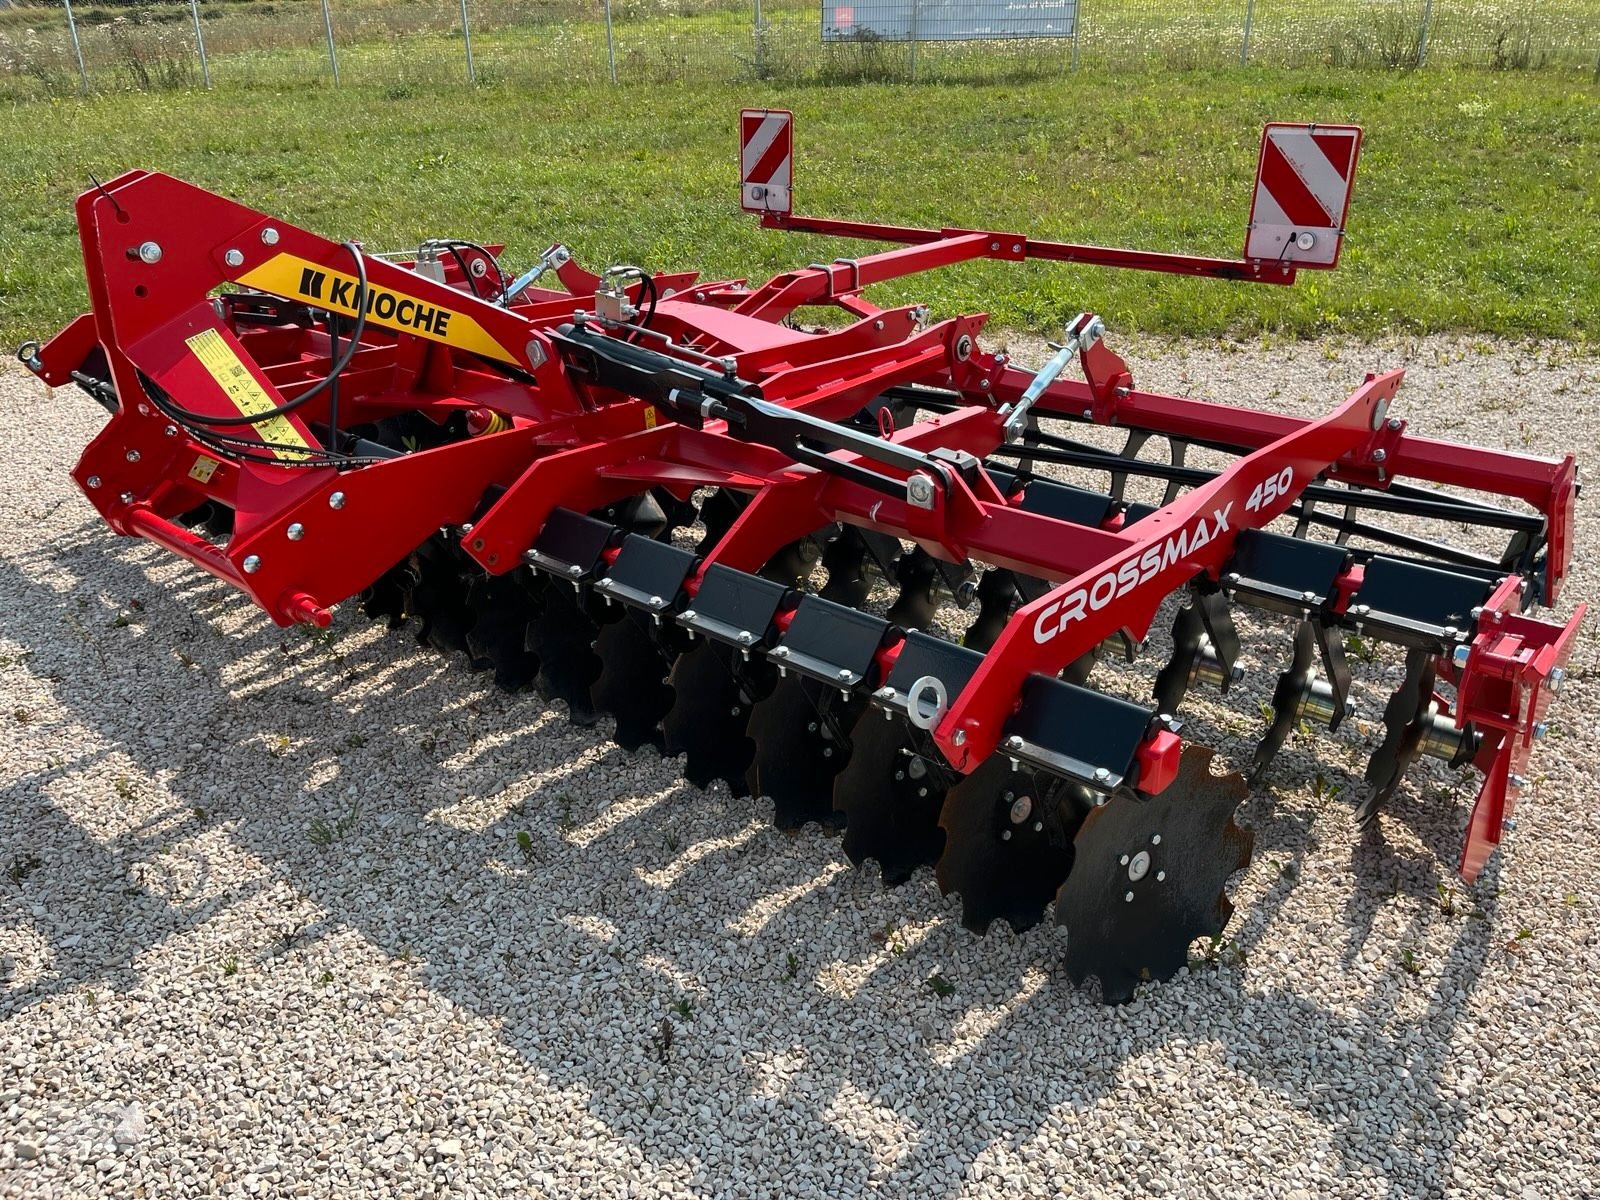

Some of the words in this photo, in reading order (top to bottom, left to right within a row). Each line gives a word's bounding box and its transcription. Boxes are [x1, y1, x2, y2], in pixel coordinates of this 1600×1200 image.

[330, 277, 451, 337] KNOCHE
[1033, 500, 1234, 645] CROSSMAX
[1245, 466, 1294, 513] 450
